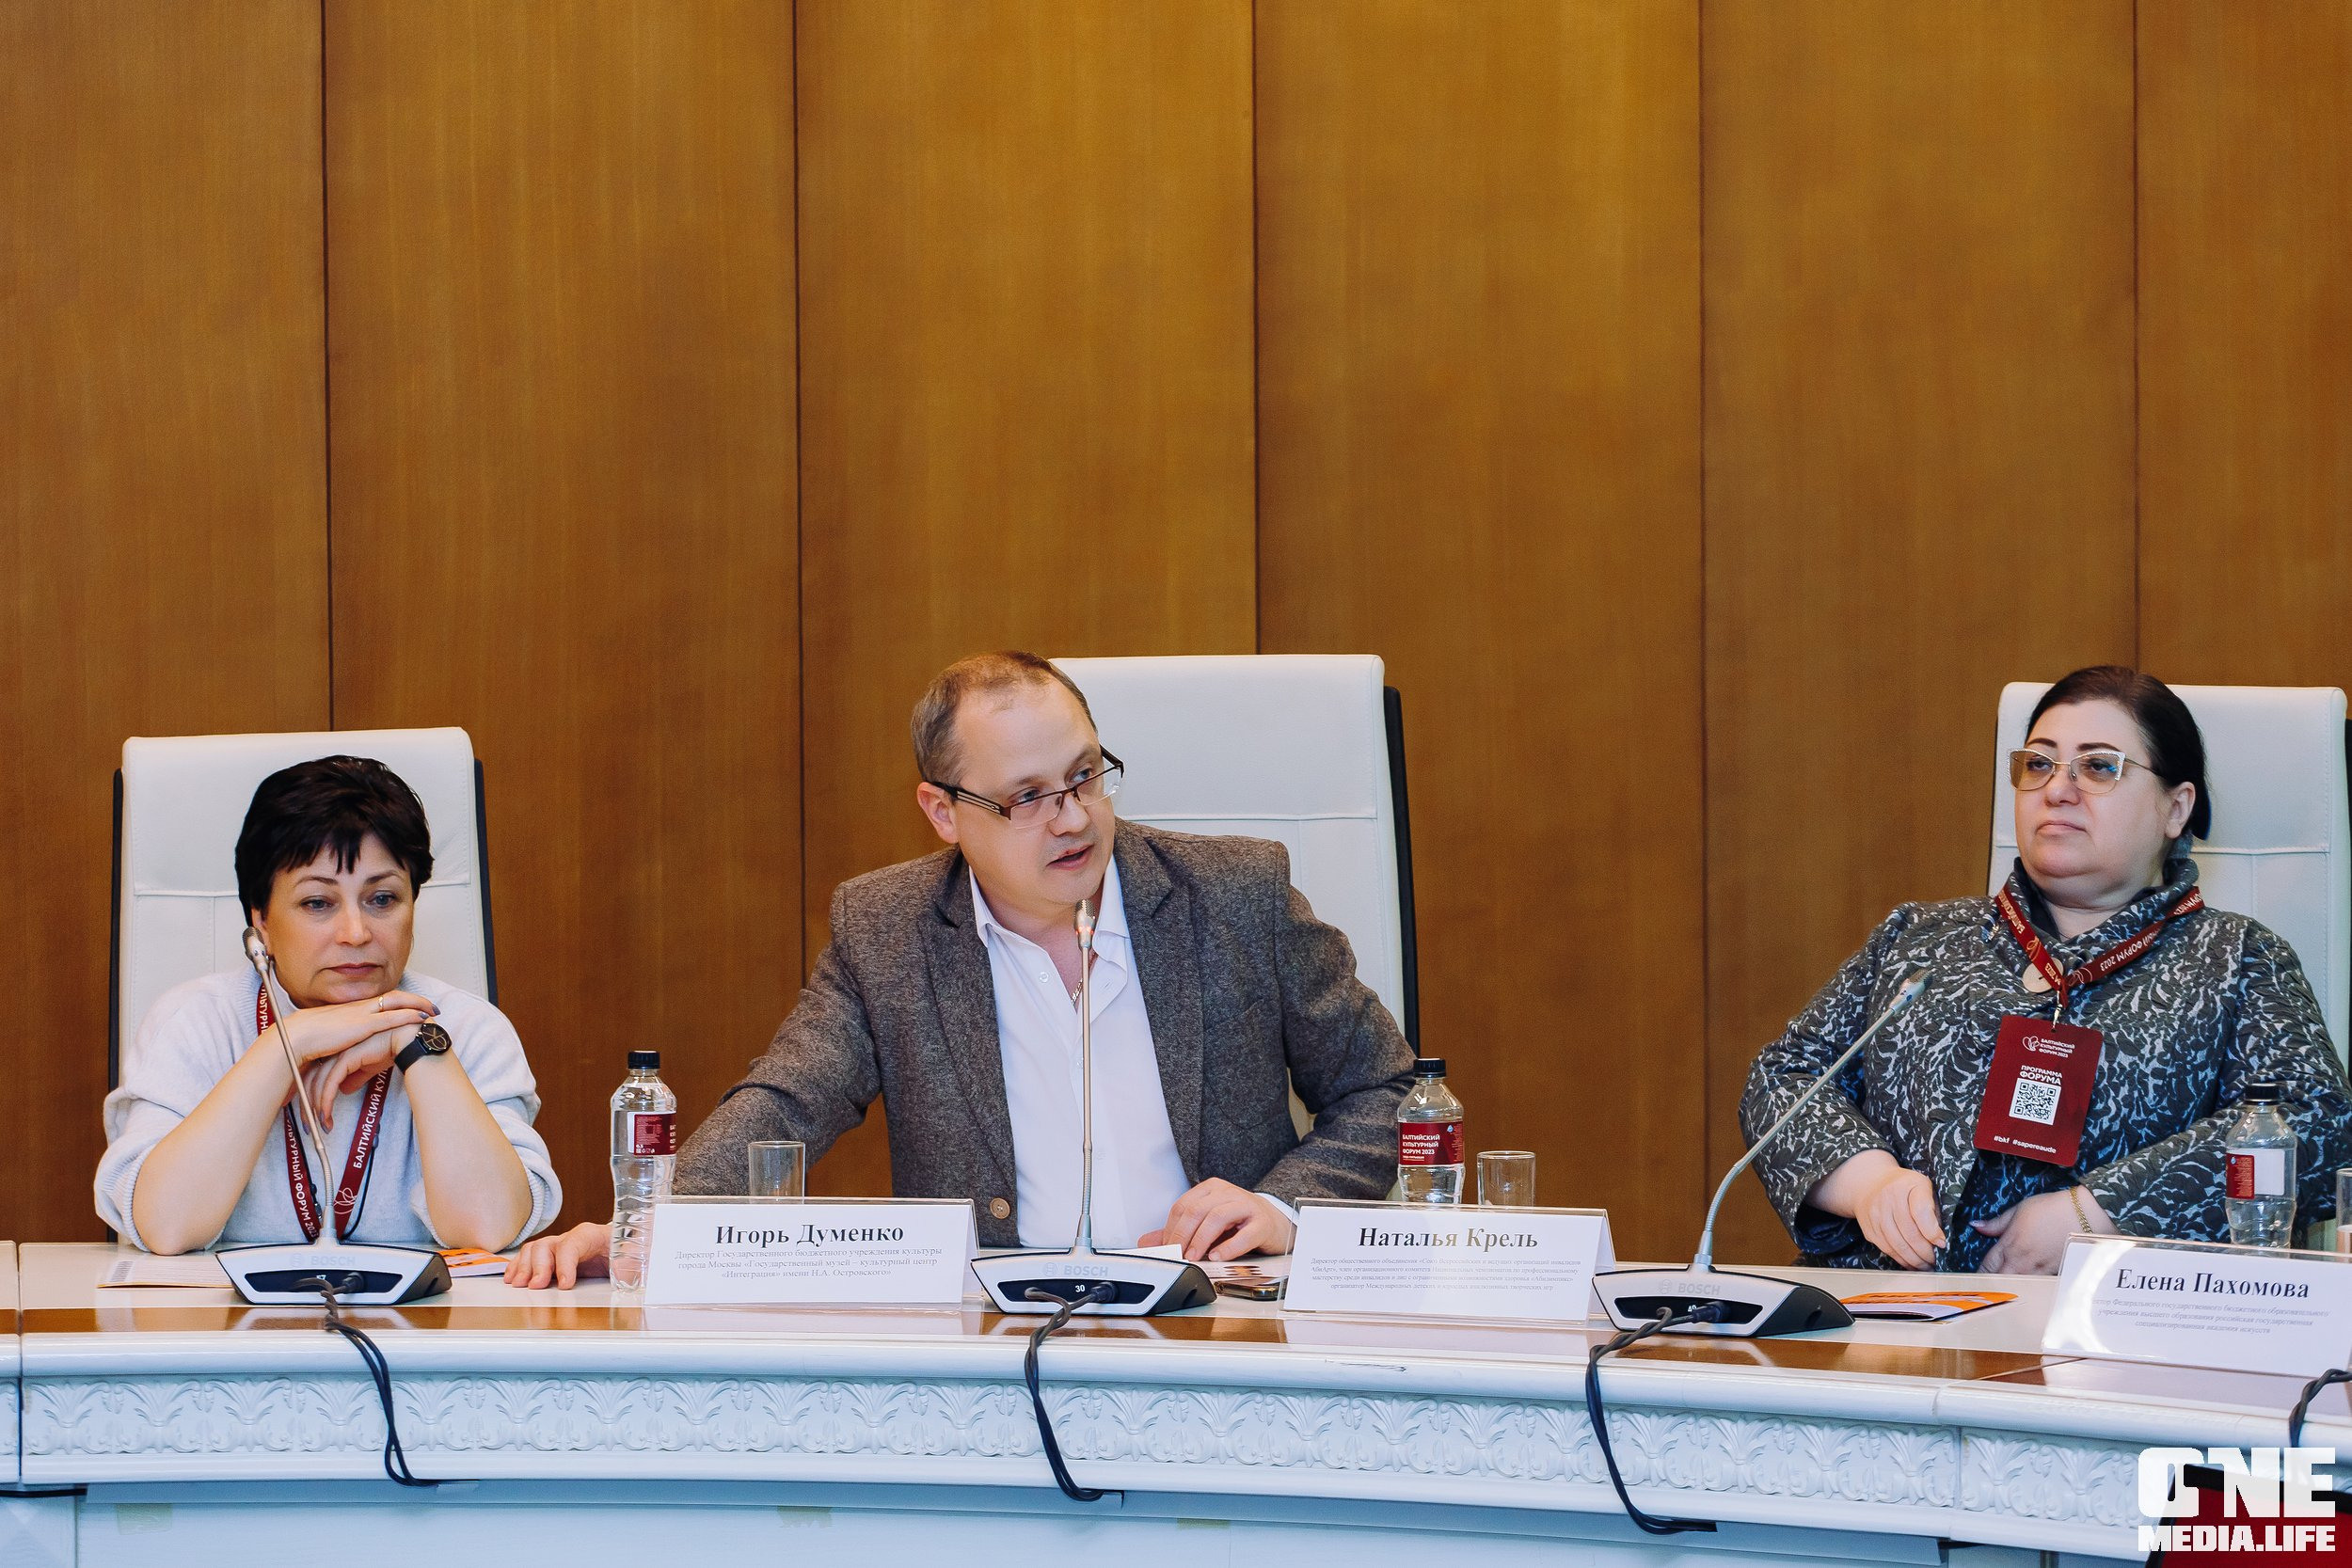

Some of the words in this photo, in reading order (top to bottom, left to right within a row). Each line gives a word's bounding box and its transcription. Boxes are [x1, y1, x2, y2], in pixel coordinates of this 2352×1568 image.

[2100, 953, 2117, 972] 2023
[2019, 1070, 2061, 1085] ФОРУМА
[2021, 1065, 2063, 1079] ПРОГРАММА
[353, 1093, 382, 1169] БАЛТИЙСКИЙ
[1994, 1134, 2010, 1144] #bkf
[294, 1181, 310, 1221] ФОРУМ
[715, 1225, 790, 1248] Игорь
[796, 1224, 905, 1248] Думенко
[1358, 1227, 1457, 1248] Наталья
[1465, 1227, 1539, 1253] Крель
[675, 1251, 715, 1260] Директор
[717, 1250, 792, 1259] Государственного
[794, 1248, 848, 1259] бюджетного
[849, 1248, 899, 1258] учреждения
[901, 1247, 942, 1257] культуры
[310, 1256, 357, 1267] BOSCH
[678, 1261, 707, 1270] города
[707, 1259, 741, 1269] Москвы
[860, 1258, 911, 1268] культурный
[913, 1258, 938, 1267] центр
[1063, 1264, 1109, 1277] BOSCH
[1074, 1284, 1087, 1293] 30
[1677, 1282, 1722, 1296] BOSCH
[2115, 1267, 2185, 1292] Елена
[2192, 1272, 2310, 1299] Пахомова
